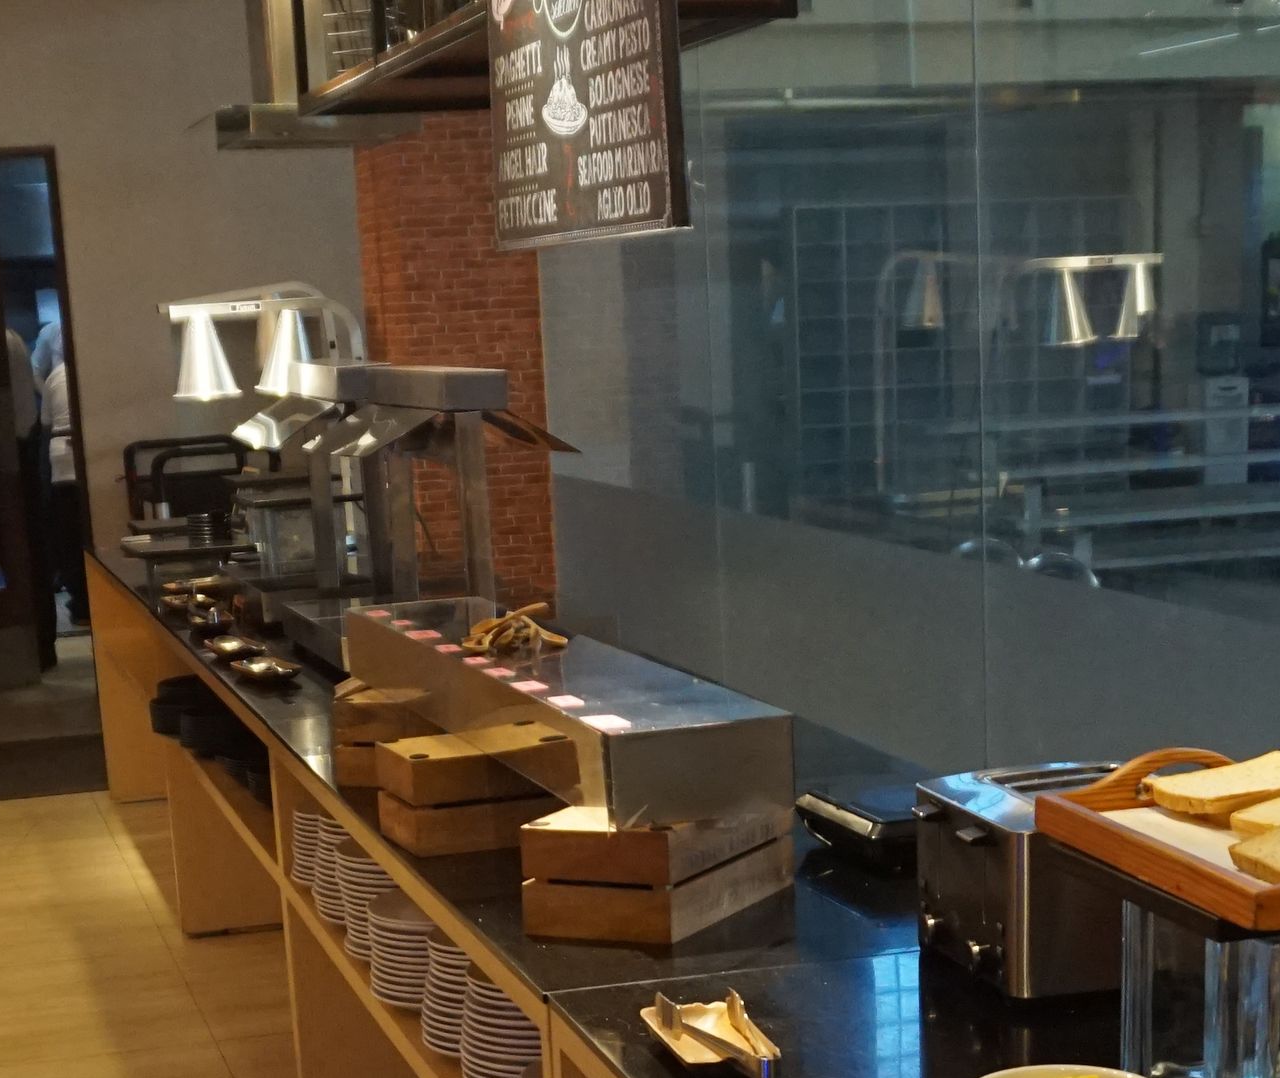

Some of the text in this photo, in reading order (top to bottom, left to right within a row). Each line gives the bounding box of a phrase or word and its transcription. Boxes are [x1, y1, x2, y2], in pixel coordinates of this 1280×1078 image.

[494, 40, 543, 88] SPAGHETTI
[580, 16, 650, 71] CREAMY PESTO
[588, 60, 651, 109] BOLOGNESE
[505, 94, 535, 131] PENNE
[589, 102, 651, 149] PUTTANESCA
[498, 142, 548, 182] ANGEL HAIR
[577, 139, 664, 186] SEAFOOD MARINARA
[498, 188, 558, 230] FETTUCCINE
[597, 181, 651, 220] AGLIO OLIO
